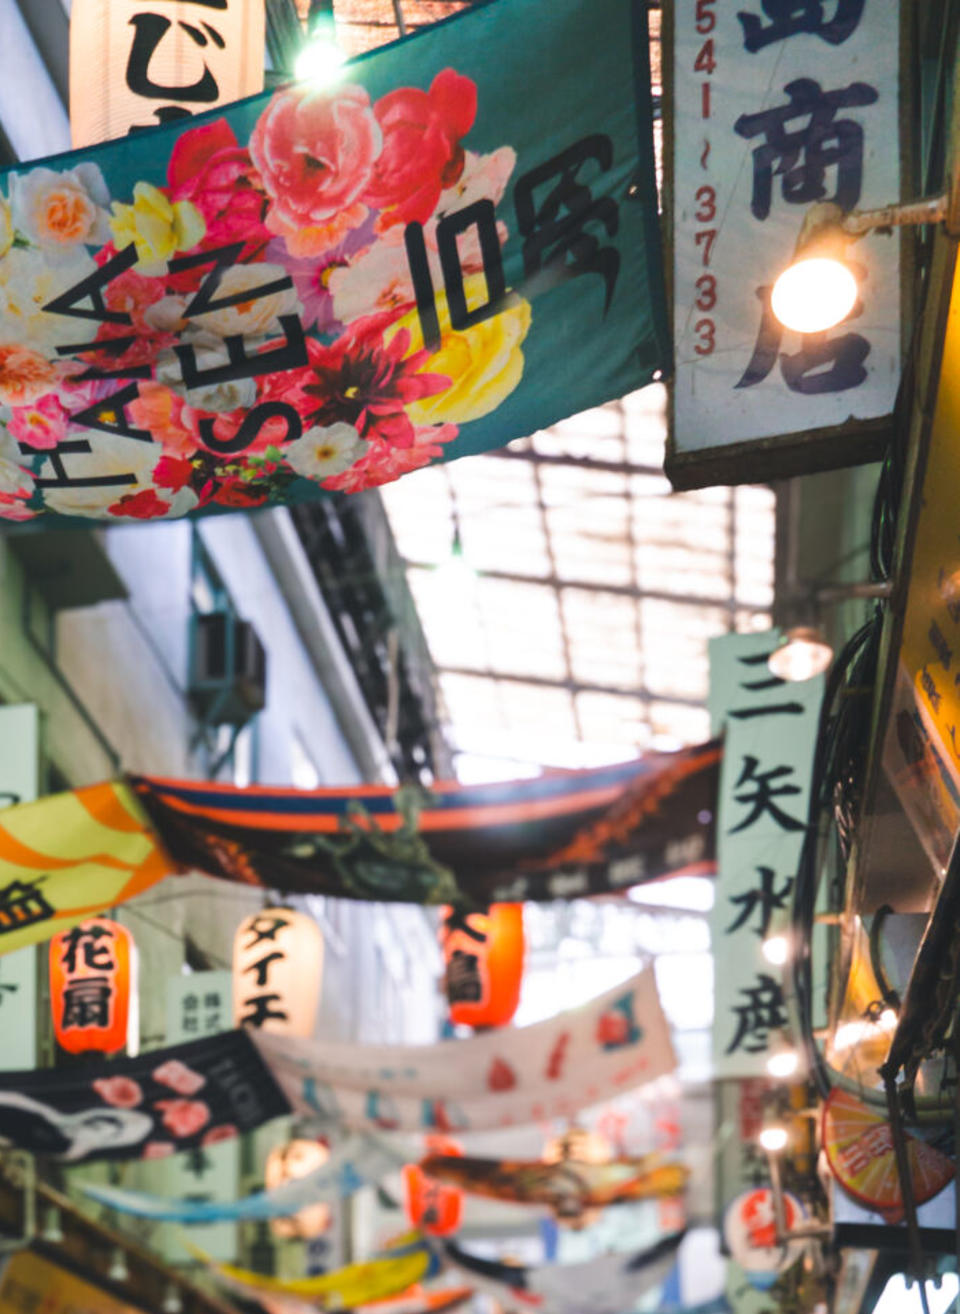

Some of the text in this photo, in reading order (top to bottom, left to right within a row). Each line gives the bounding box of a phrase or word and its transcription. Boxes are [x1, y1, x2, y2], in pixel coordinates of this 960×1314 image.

[20, 241, 154, 491] HANA
[168, 240, 311, 456] SEN
[725, 652, 808, 1056] 三矢水産
[59, 923, 115, 1031] 花扇
